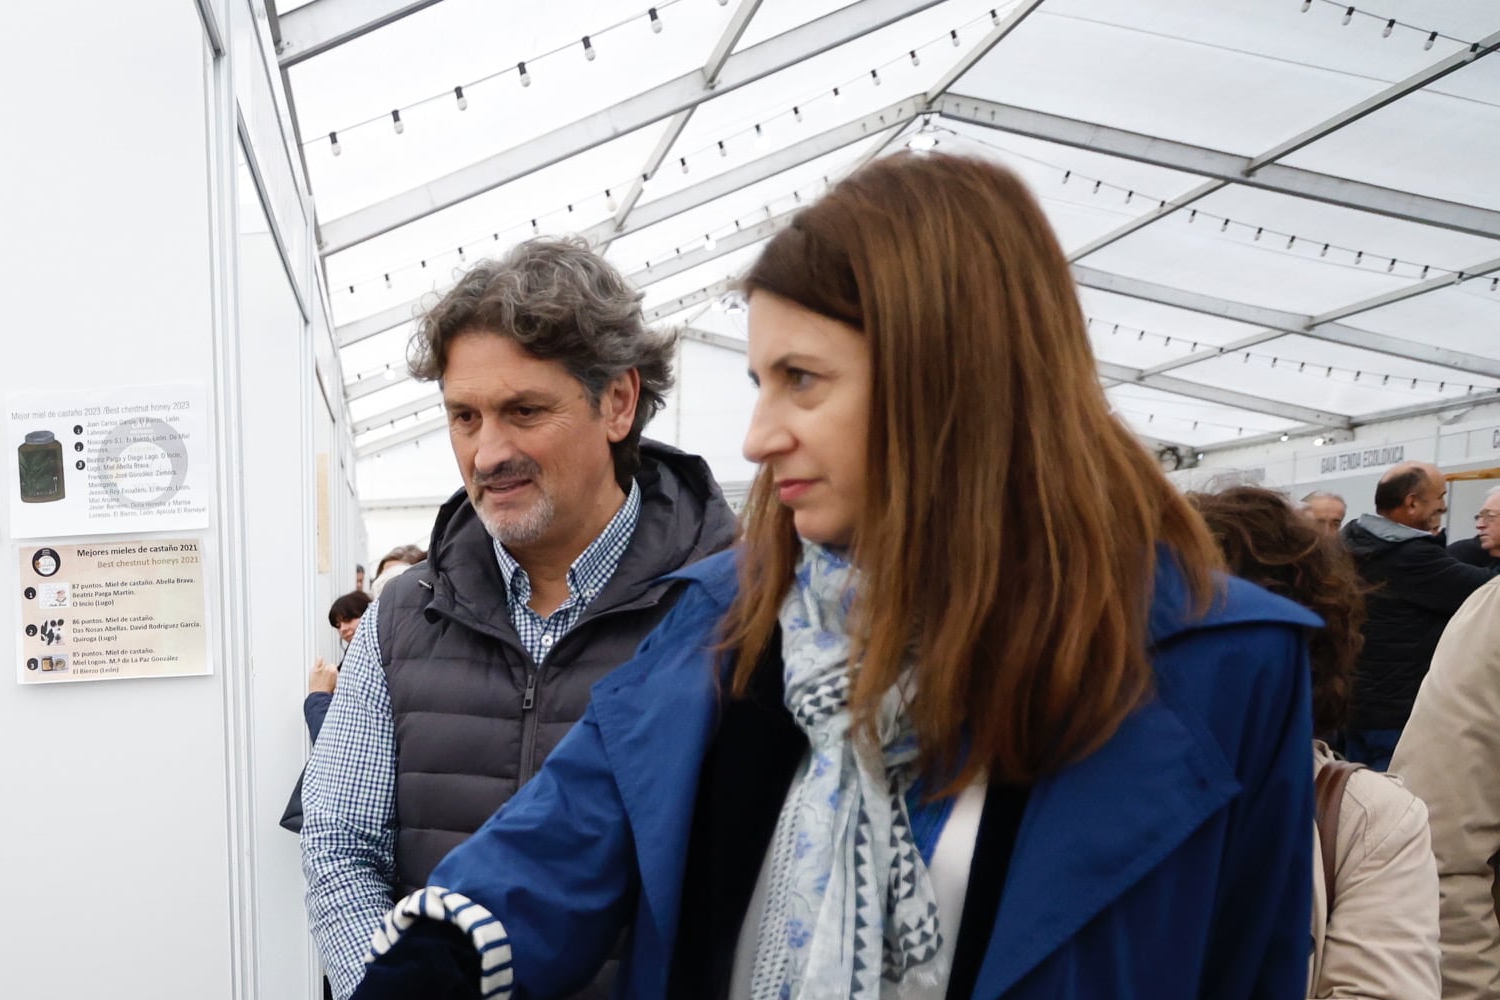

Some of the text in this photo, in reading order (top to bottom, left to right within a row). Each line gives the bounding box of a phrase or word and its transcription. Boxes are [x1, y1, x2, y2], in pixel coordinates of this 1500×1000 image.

[12, 411, 30, 421] Mejor
[32, 409, 46, 419] miel
[47, 409, 56, 418] de
[58, 408, 83, 418] castaño
[84, 407, 101, 416] 2023
[121, 403, 149, 414] chestnut
[151, 402, 171, 412] honey
[172, 400, 190, 410] 2023
[77, 548, 108, 557] Mejores
[110, 548, 136, 556] mieles
[149, 545, 178, 553] castaño
[180, 544, 198, 552] 2021
[97, 556, 199, 568] Best chestnut honeys 2021
[80, 582, 104, 591] puntos.
[130, 579, 155, 587] castaño.
[94, 590, 112, 598] Parga
[79, 599, 94, 607] Incio
[95, 599, 115, 607] (Lugo)
[81, 617, 104, 626] puntos.
[105, 616, 119, 624] Miel
[129, 614, 155, 622] castaño.
[84, 625, 103, 633] Nosas
[73, 634, 117, 643] Quiroga (Lugo)
[81, 649, 104, 659] puntos.
[105, 648, 119, 656] Miel
[130, 647, 155, 655] castaño.
[131, 656, 138, 664] La
[100, 666, 119, 675] (León)
